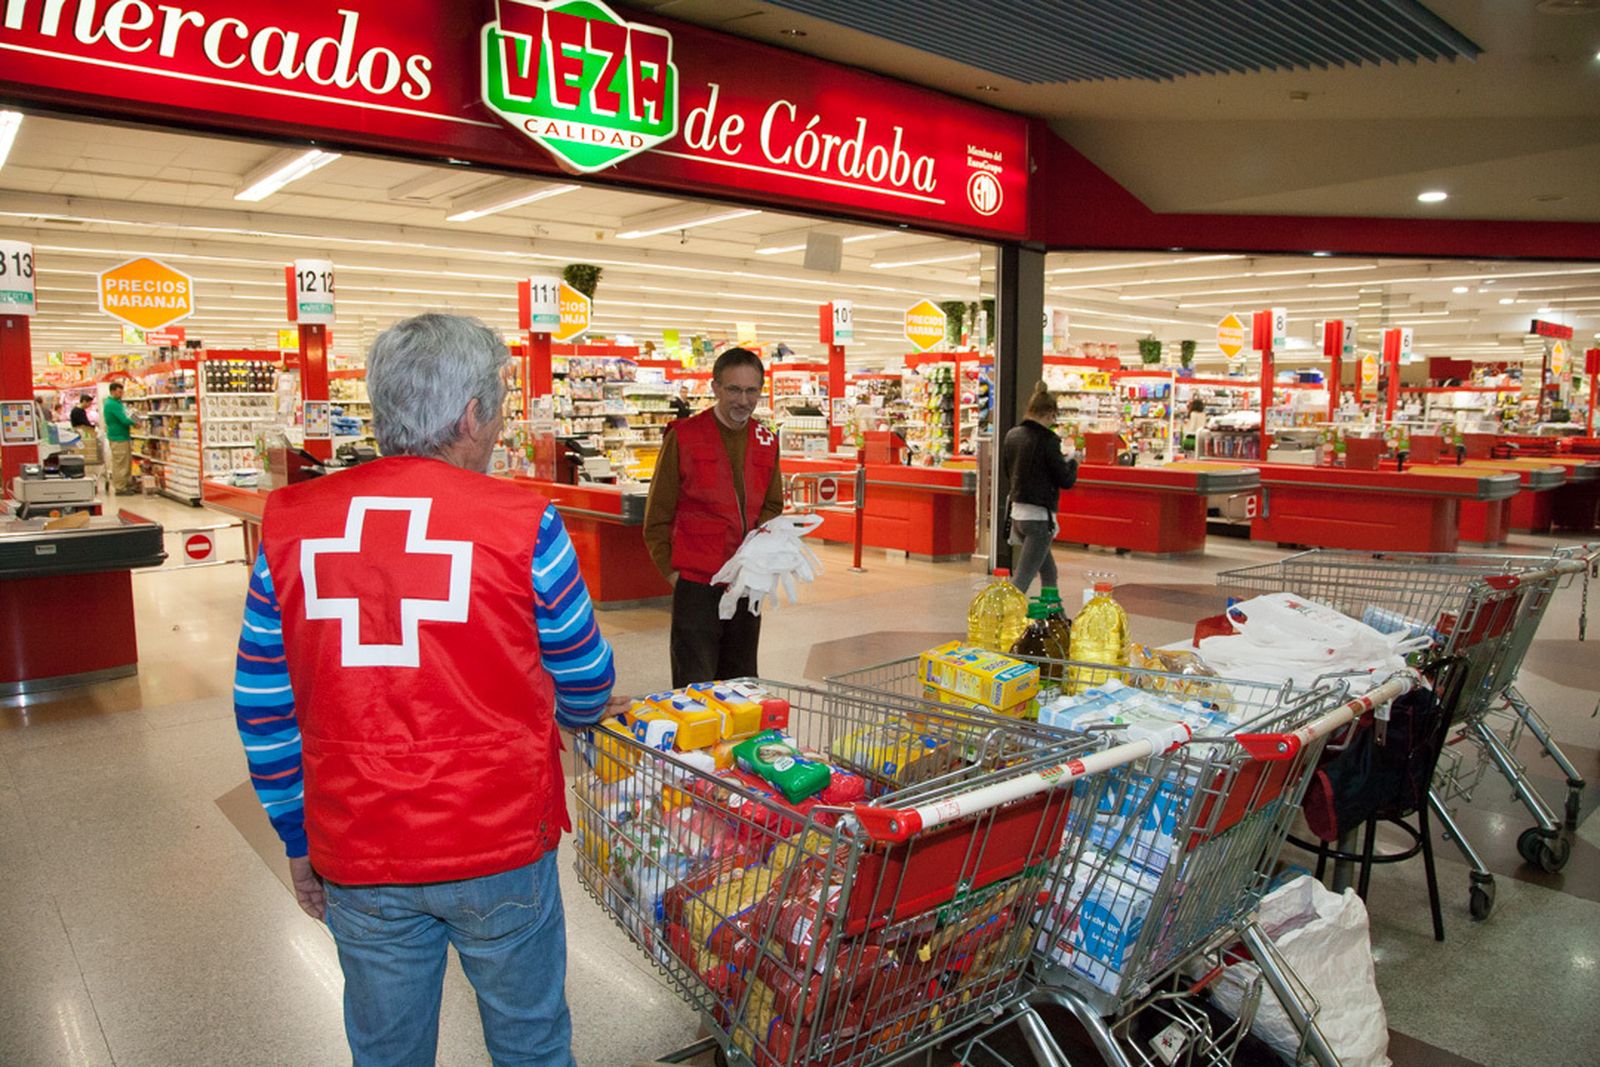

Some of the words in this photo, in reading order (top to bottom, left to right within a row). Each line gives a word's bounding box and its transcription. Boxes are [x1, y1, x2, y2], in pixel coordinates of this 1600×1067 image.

[523, 118, 644, 148] CALIDAD
[684, 82, 745, 156] de
[760, 99, 937, 193] Córdoba
[11, 252, 34, 278] 13
[105, 278, 187, 294] PRECIOS
[297, 270, 316, 292] 12
[320, 271, 335, 293] 12
[106, 296, 187, 309] NARANJA
[560, 301, 587, 313] CIOS
[834, 307, 848, 323] 10
[1276, 315, 1284, 331] 8
[1345, 326, 1352, 340] 7
